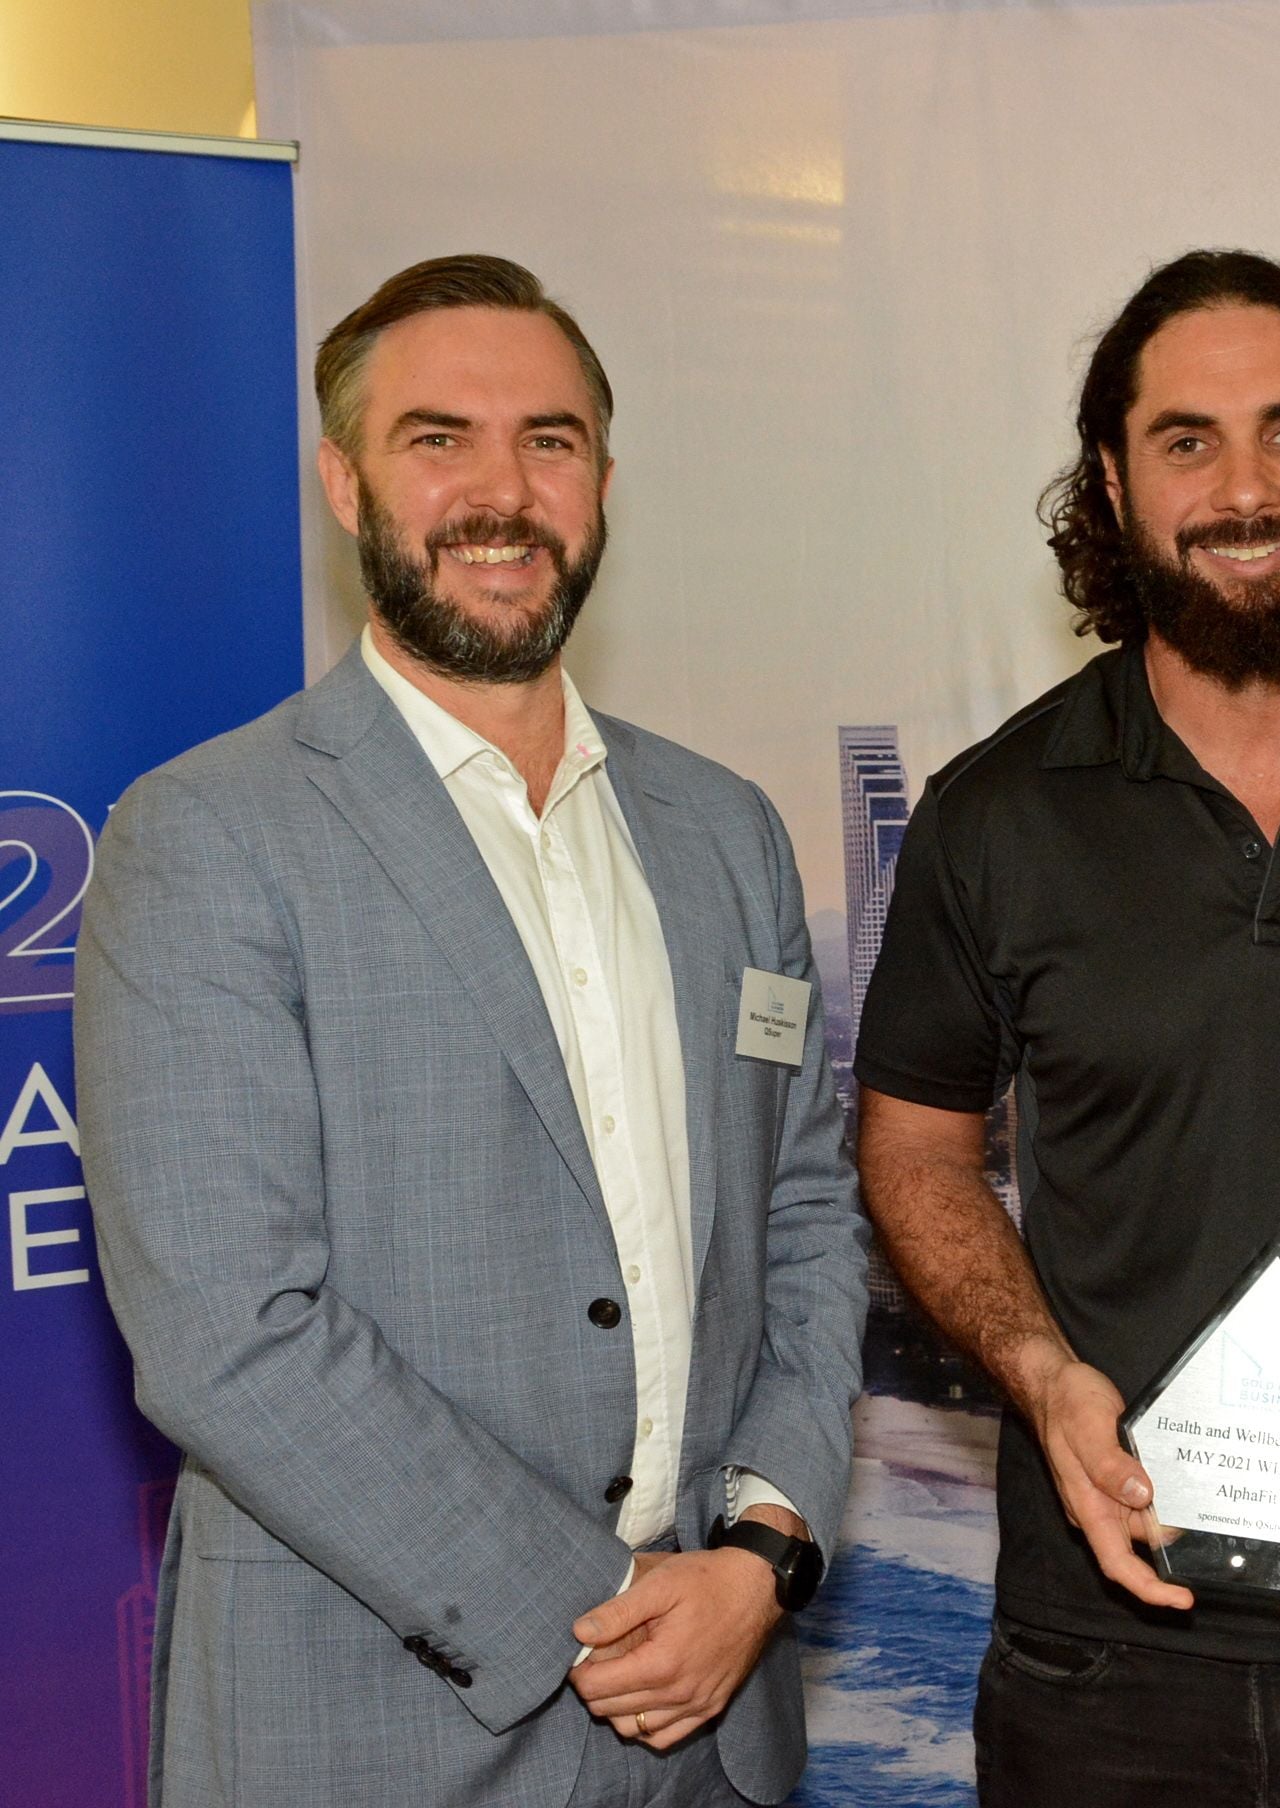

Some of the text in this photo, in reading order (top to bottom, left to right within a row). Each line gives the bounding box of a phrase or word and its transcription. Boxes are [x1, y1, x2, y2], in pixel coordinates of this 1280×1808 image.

[750, 1011, 770, 1024] Michael
[1241, 1377, 1274, 1390] GOLD
[1157, 1416, 1202, 1436] Health
[1206, 1425, 1231, 1441] and
[1176, 1447, 1216, 1465] MAY
[1218, 1453, 1251, 1472] 2021
[1216, 1483, 1277, 1506] AlphaFit
[1197, 1512, 1241, 1526] sponsored
[1243, 1517, 1253, 1528] by
